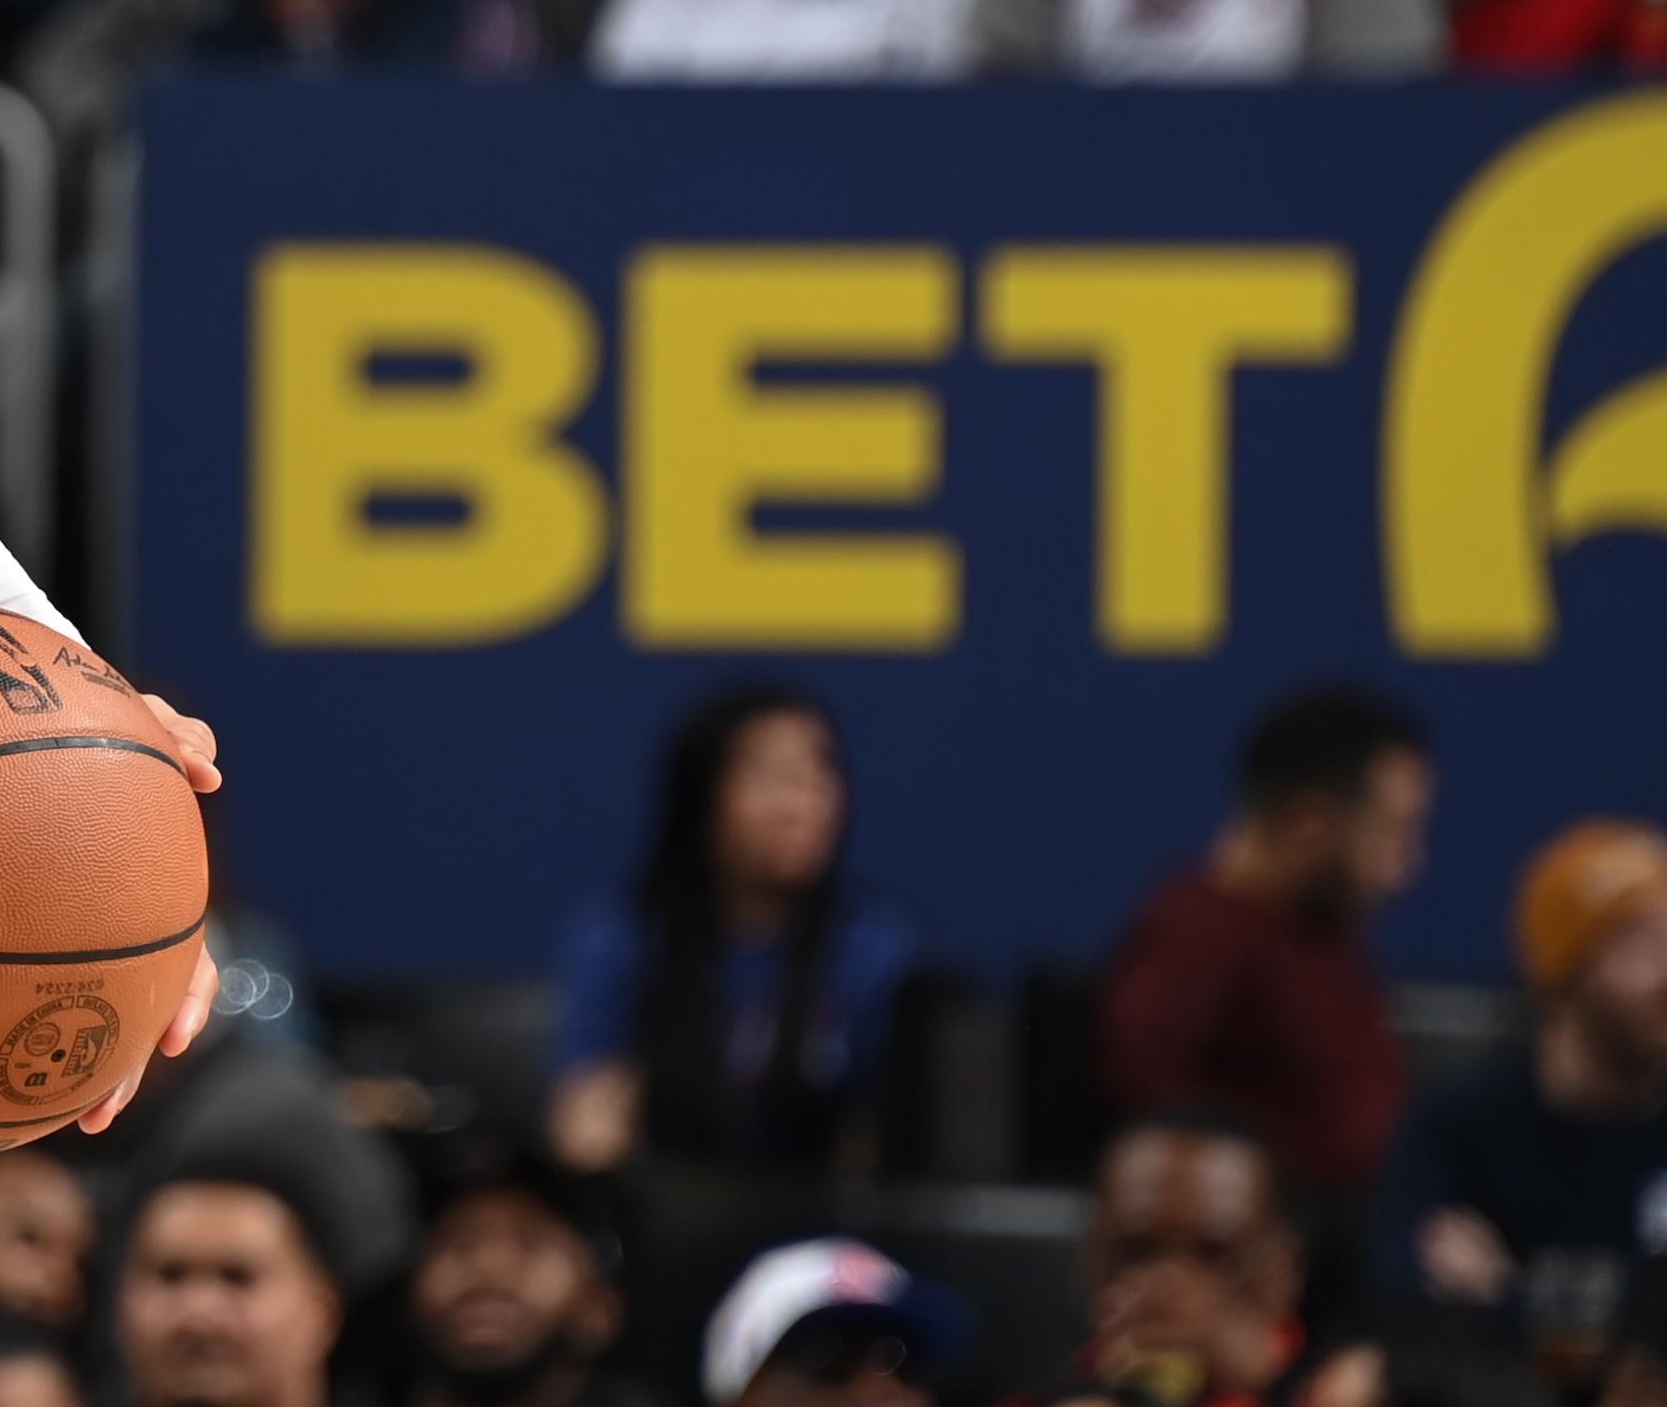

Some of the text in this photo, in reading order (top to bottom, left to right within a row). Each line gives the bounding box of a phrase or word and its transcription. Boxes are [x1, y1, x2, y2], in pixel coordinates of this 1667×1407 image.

[252, 242, 1359, 656] BET
[7, 1022, 29, 1047] MADE
[36, 1001, 64, 1019] CHINA
